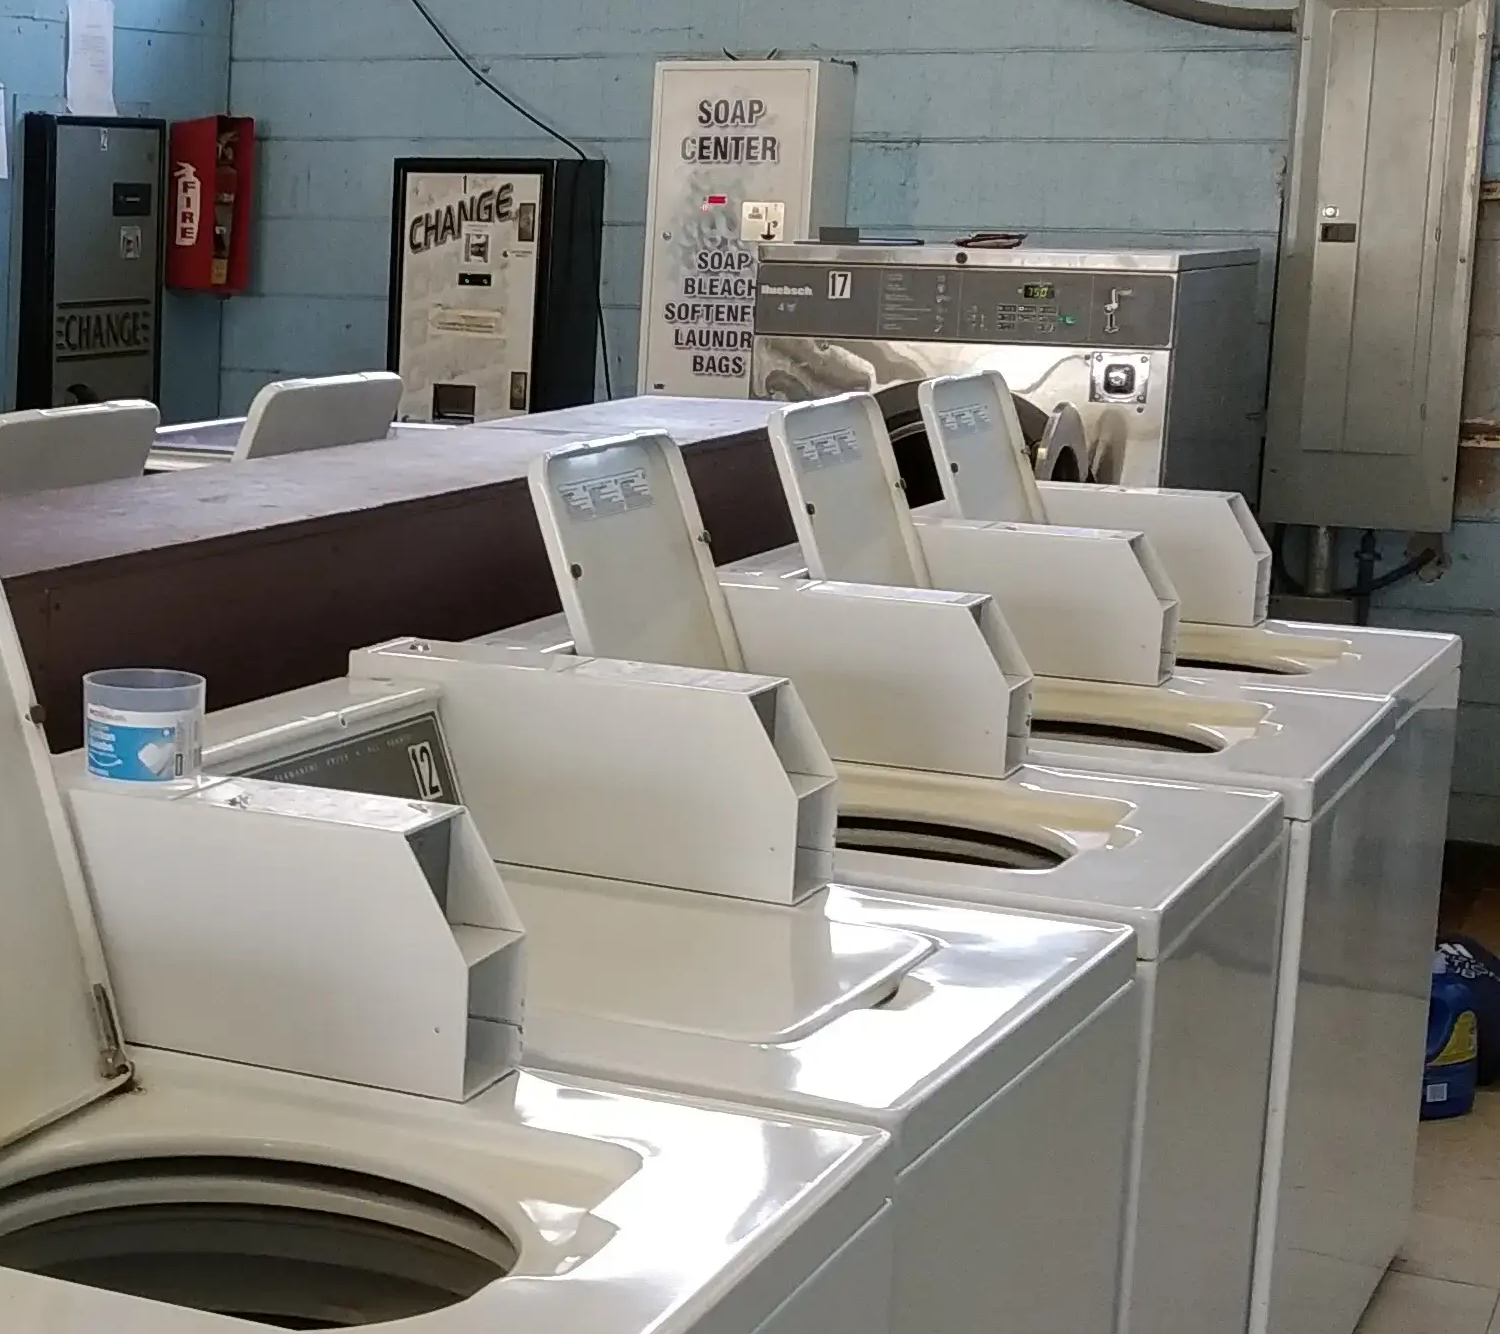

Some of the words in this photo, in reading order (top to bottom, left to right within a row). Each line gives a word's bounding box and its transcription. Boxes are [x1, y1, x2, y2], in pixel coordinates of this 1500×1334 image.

[697, 98, 766, 127] SOAP
[680, 135, 779, 163] CENTER
[180, 181, 197, 239] FIRE
[409, 182, 515, 255] CHANGE
[697, 251, 751, 271] SOAP
[684, 277, 757, 297] BLEACH
[830, 273, 849, 297] 17
[664, 302, 755, 322] SOFTENE
[64, 311, 141, 351] CHANGE
[674, 328, 752, 349] LAUNDR
[691, 354, 744, 375] BAGS
[411, 745, 440, 797] 12
